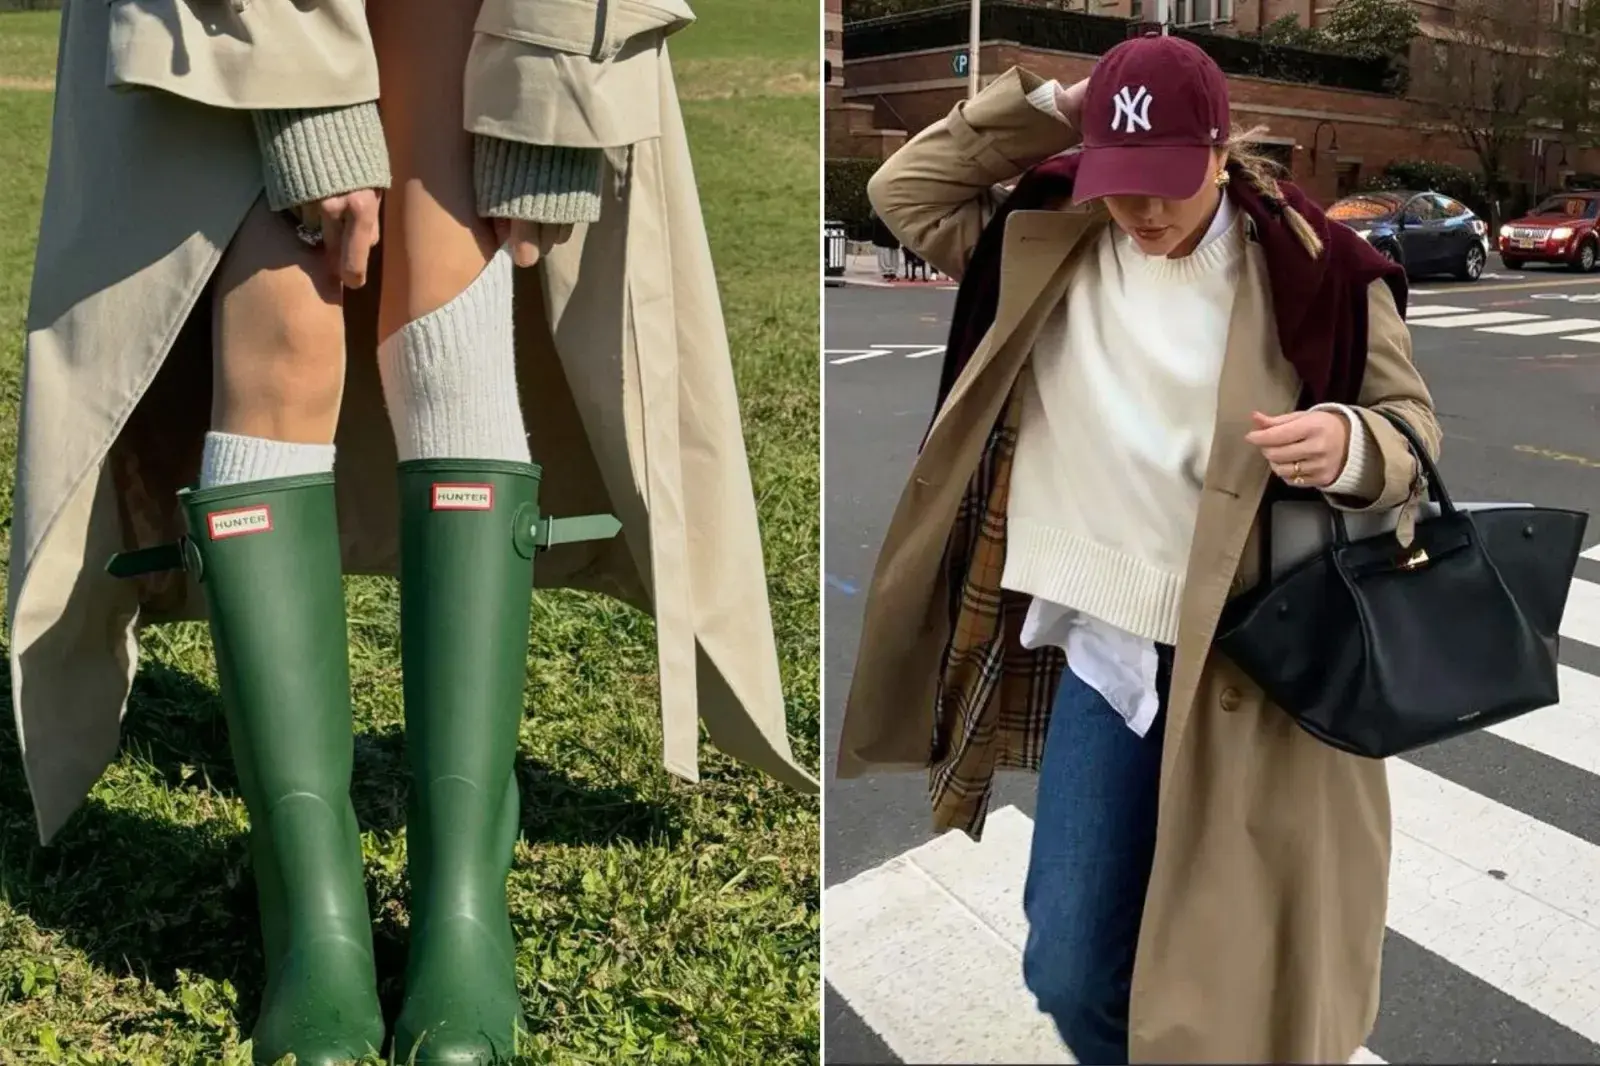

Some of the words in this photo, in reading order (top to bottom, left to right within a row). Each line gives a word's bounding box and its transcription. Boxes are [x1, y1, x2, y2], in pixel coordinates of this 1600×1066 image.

[959, 55, 968, 73] P
[1111, 86, 1153, 133] NY
[437, 492, 488, 502] HUNTER
[214, 514, 266, 530] HUNTER
